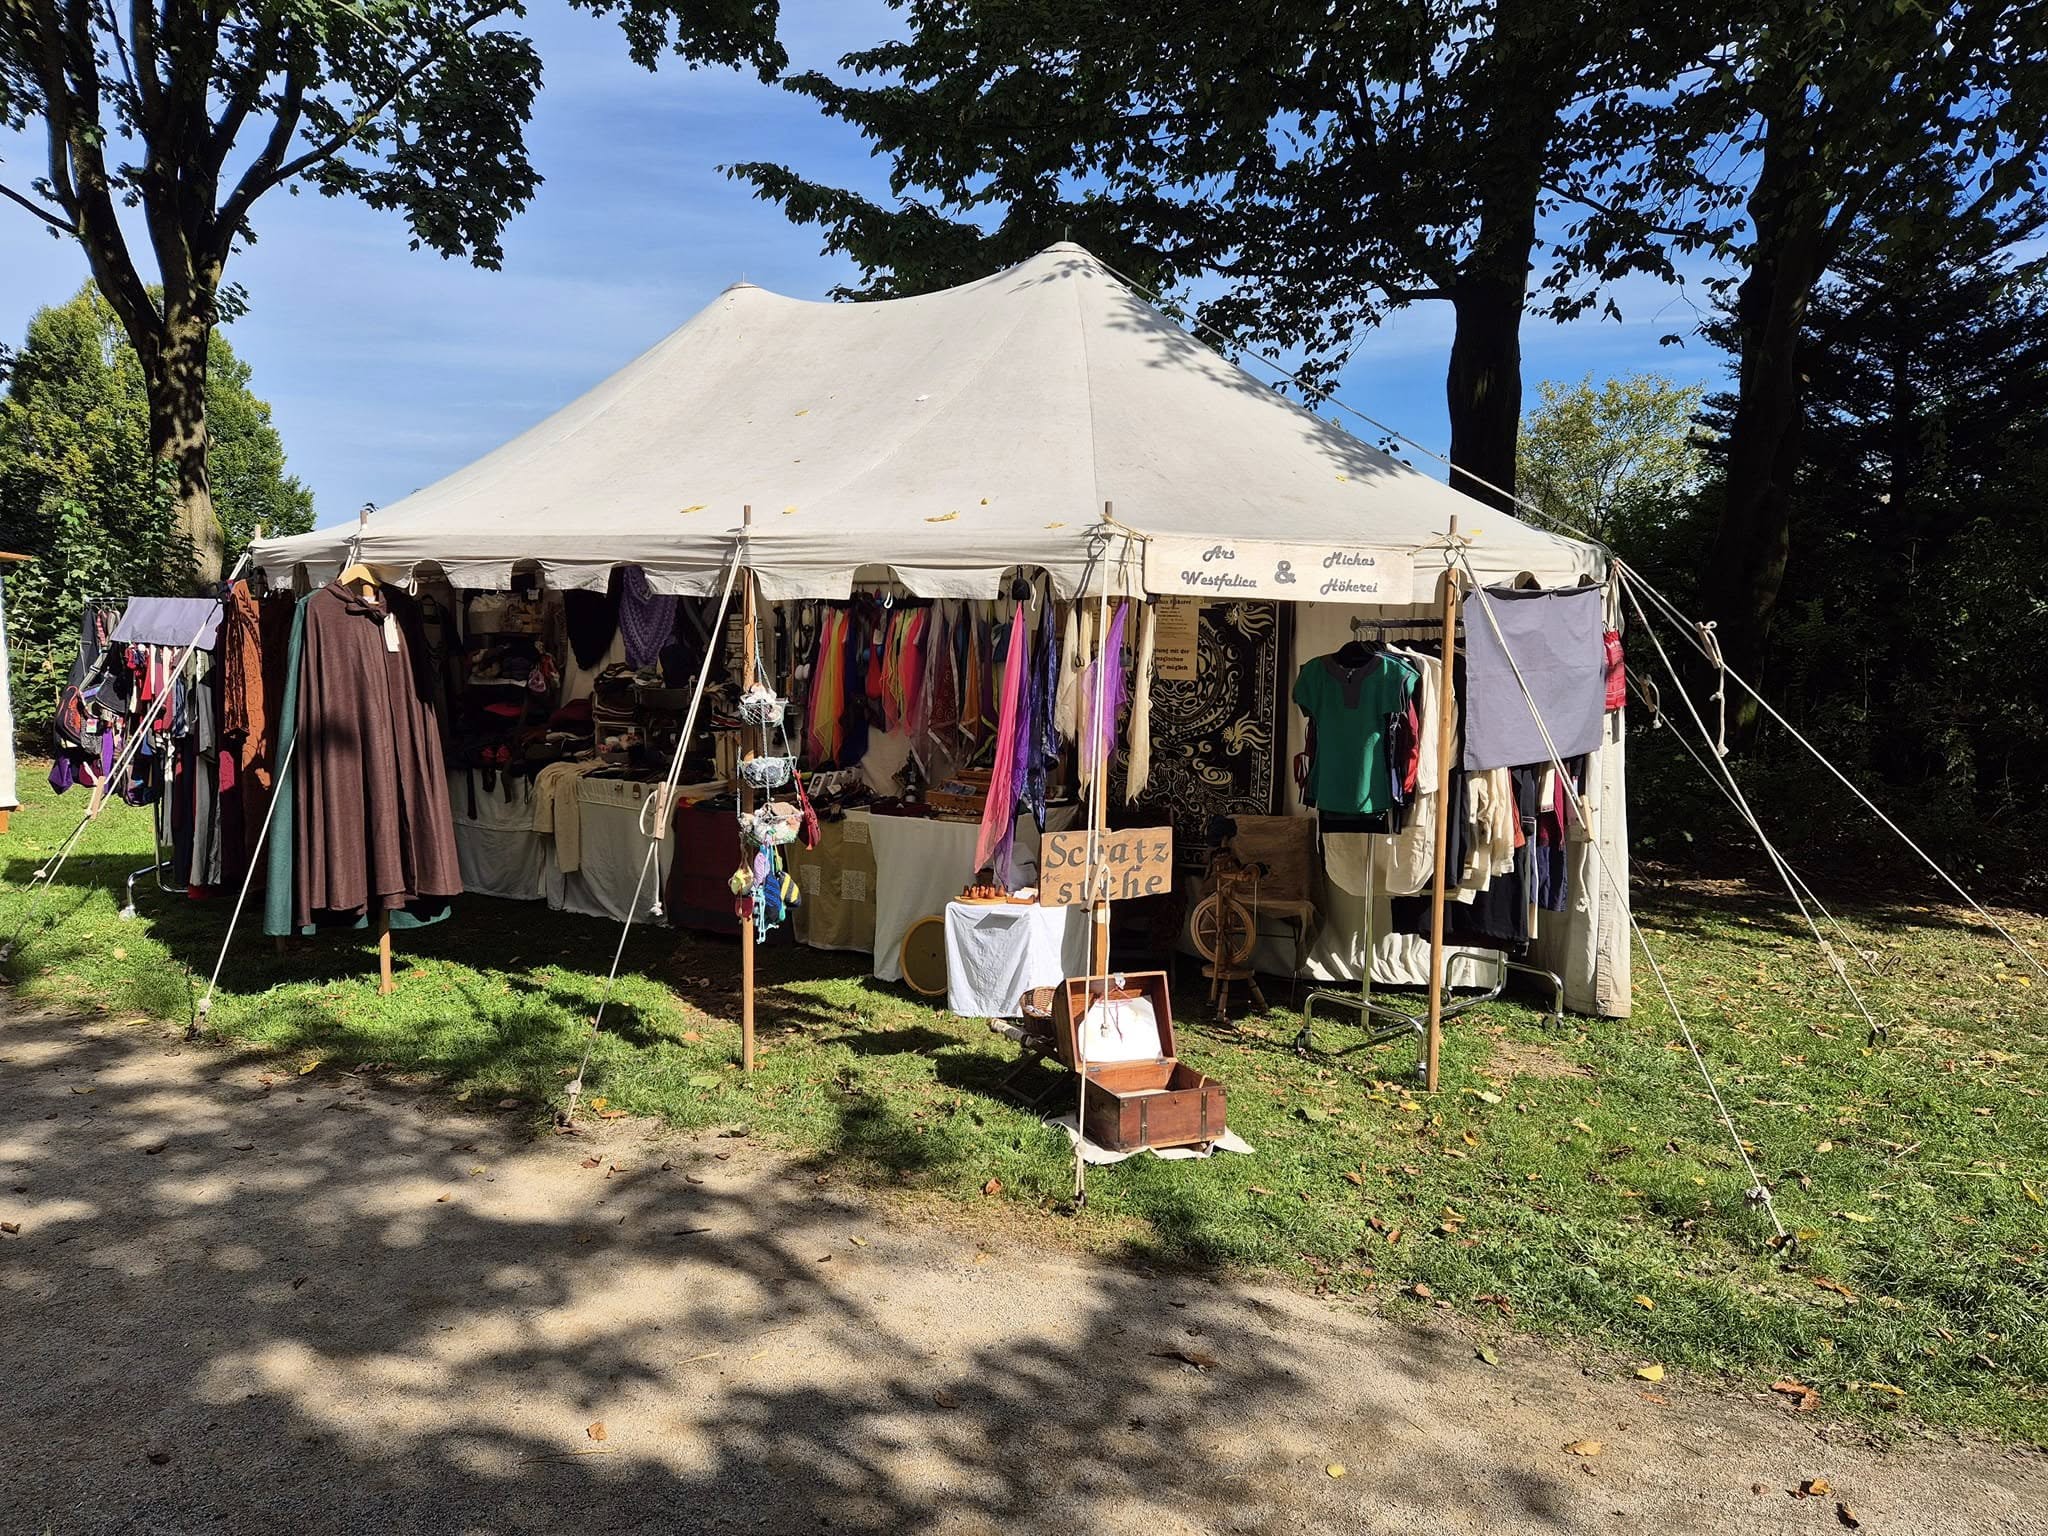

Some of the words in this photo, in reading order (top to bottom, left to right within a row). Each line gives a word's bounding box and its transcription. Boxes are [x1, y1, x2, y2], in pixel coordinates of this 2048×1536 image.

[1202, 545, 1235, 563] Ars
[1323, 552, 1375, 568] Michas
[1274, 560, 1296, 584] &
[1181, 571, 1257, 592] Westfalica
[1320, 577, 1378, 595] Hökerei
